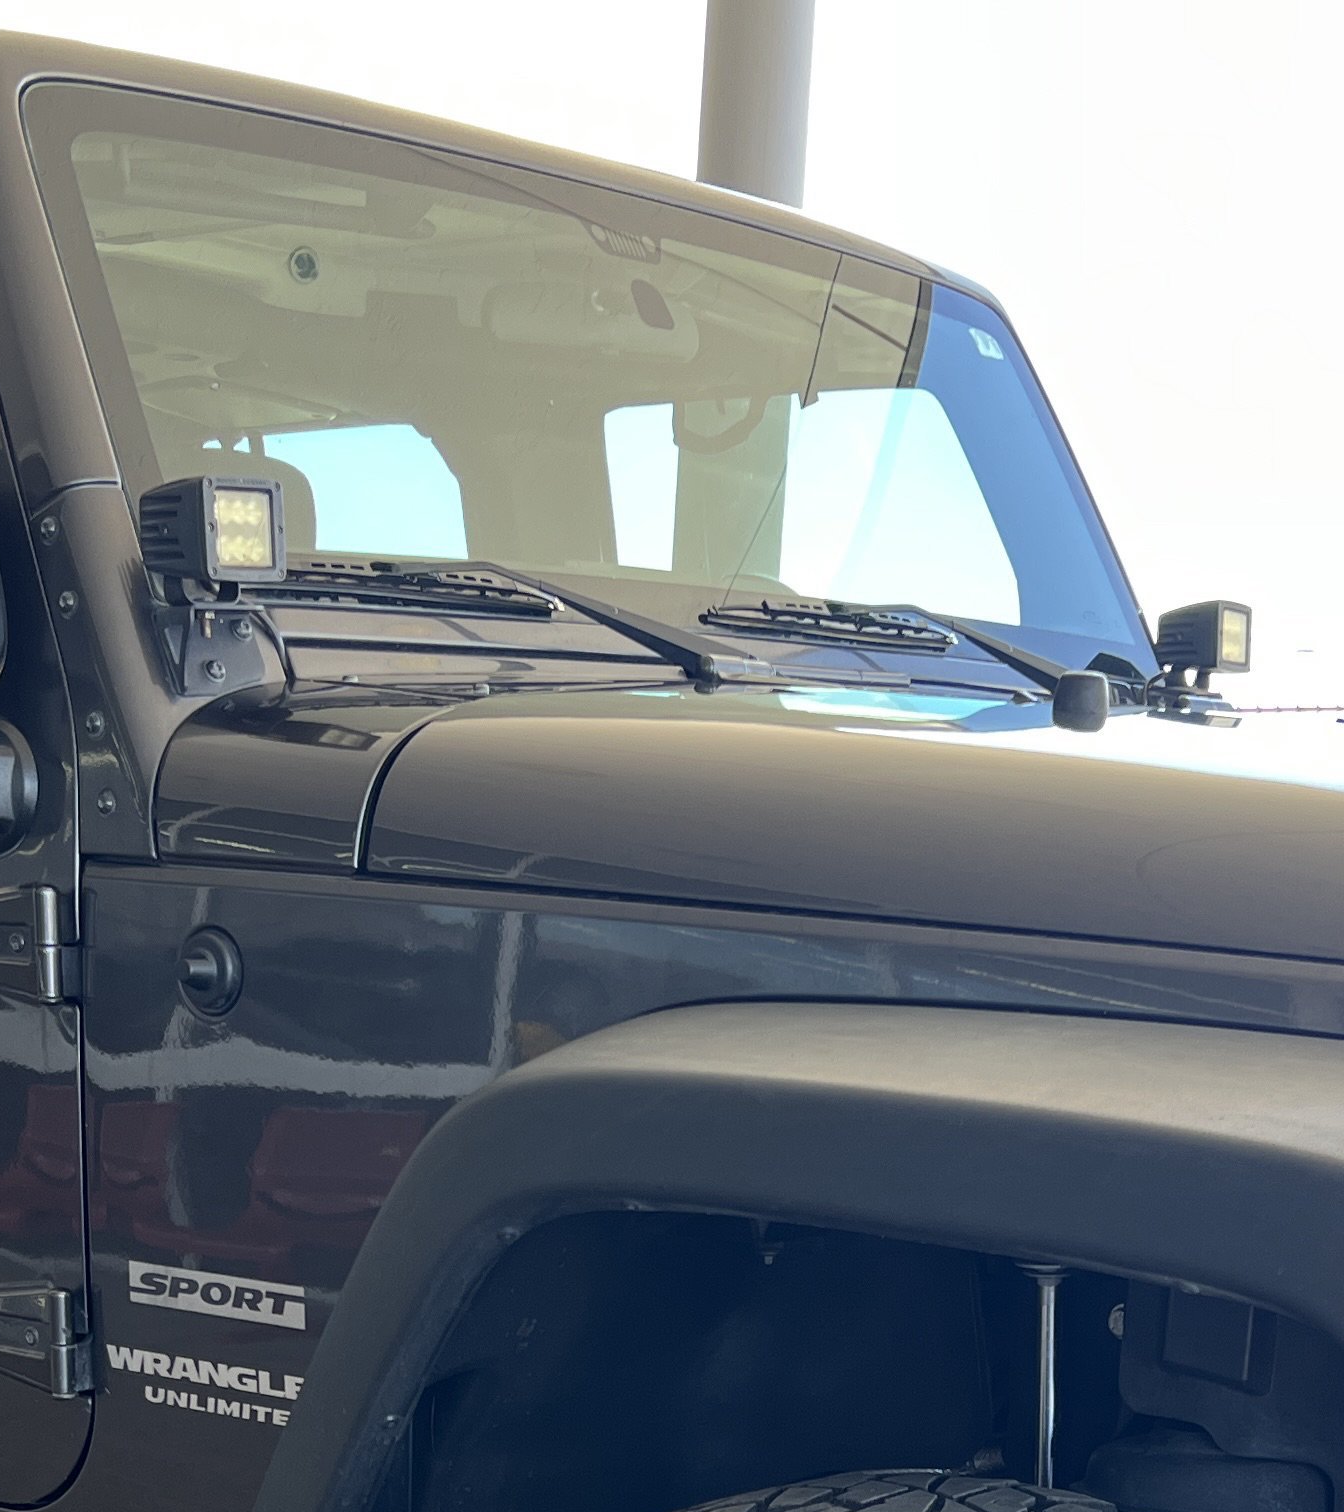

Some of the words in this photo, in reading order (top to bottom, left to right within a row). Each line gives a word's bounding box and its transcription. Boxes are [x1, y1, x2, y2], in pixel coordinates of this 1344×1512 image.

[136, 1270, 304, 1318] SPORT
[106, 1344, 305, 1401] WRANGLE
[144, 1385, 292, 1427] UNLIMITE
